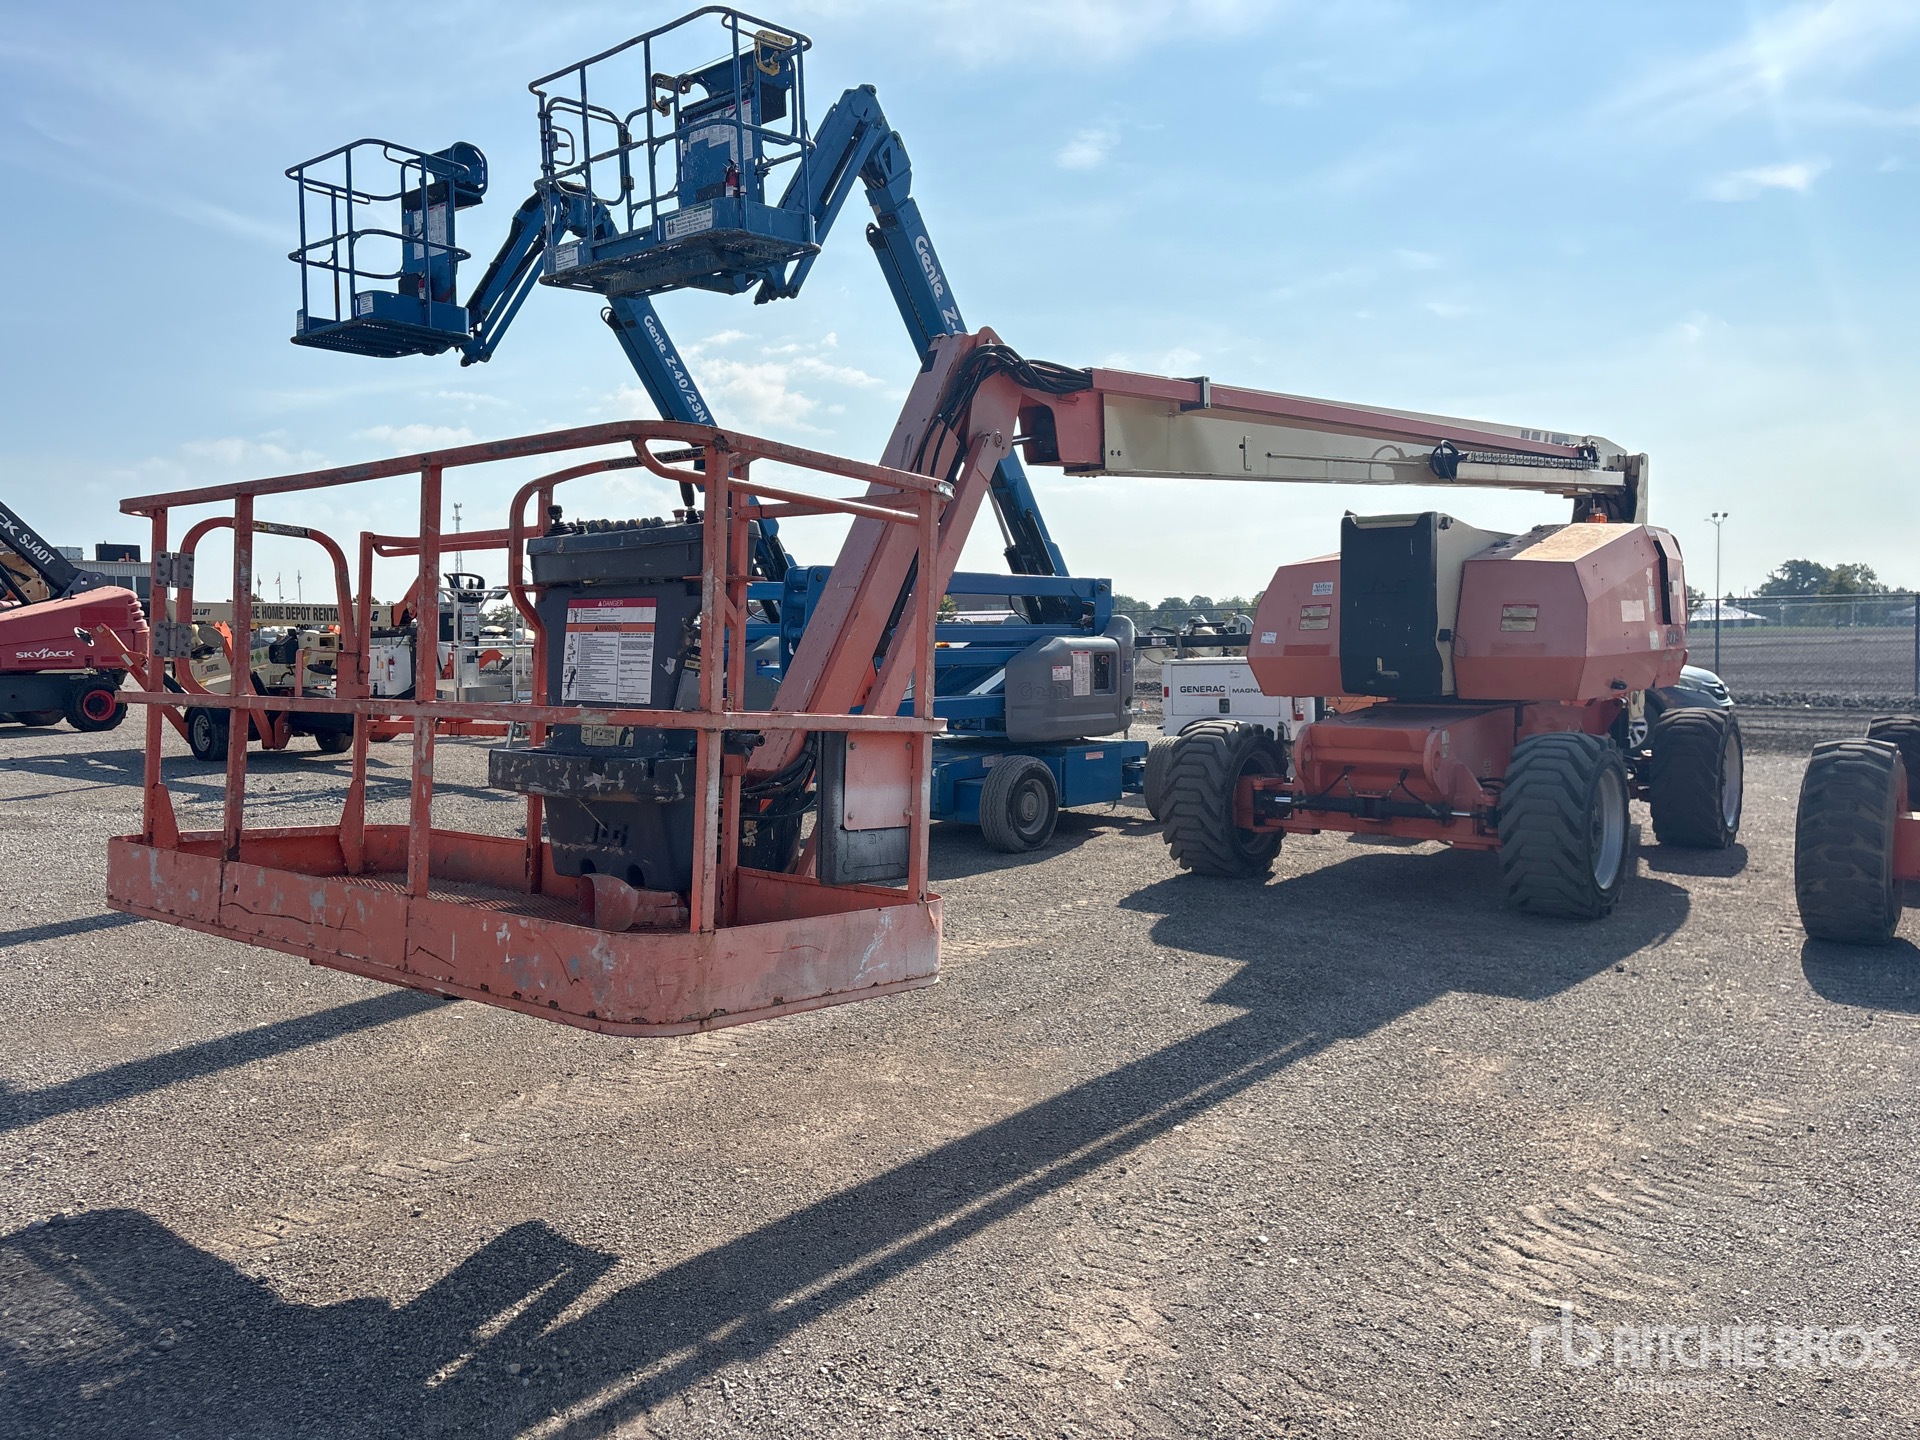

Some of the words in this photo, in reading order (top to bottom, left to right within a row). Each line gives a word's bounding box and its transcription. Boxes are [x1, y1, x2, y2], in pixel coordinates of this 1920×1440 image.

[915, 235, 945, 299] Genie
[942, 306, 964, 335] Z-
[643, 314, 667, 354] Genie
[664, 355, 708, 423] Z-40/23N
[18, 533, 56, 566] SJ40T
[602, 599, 624, 607] DANGER
[251, 605, 260, 619] HE
[261, 605, 284, 620] HOME
[286, 606, 311, 621] DEPOT
[313, 607, 340, 622] RENTA
[598, 624, 623, 632] WARNING
[15, 647, 75, 659] SKYJACK
[1179, 685, 1226, 693] GENERAC
